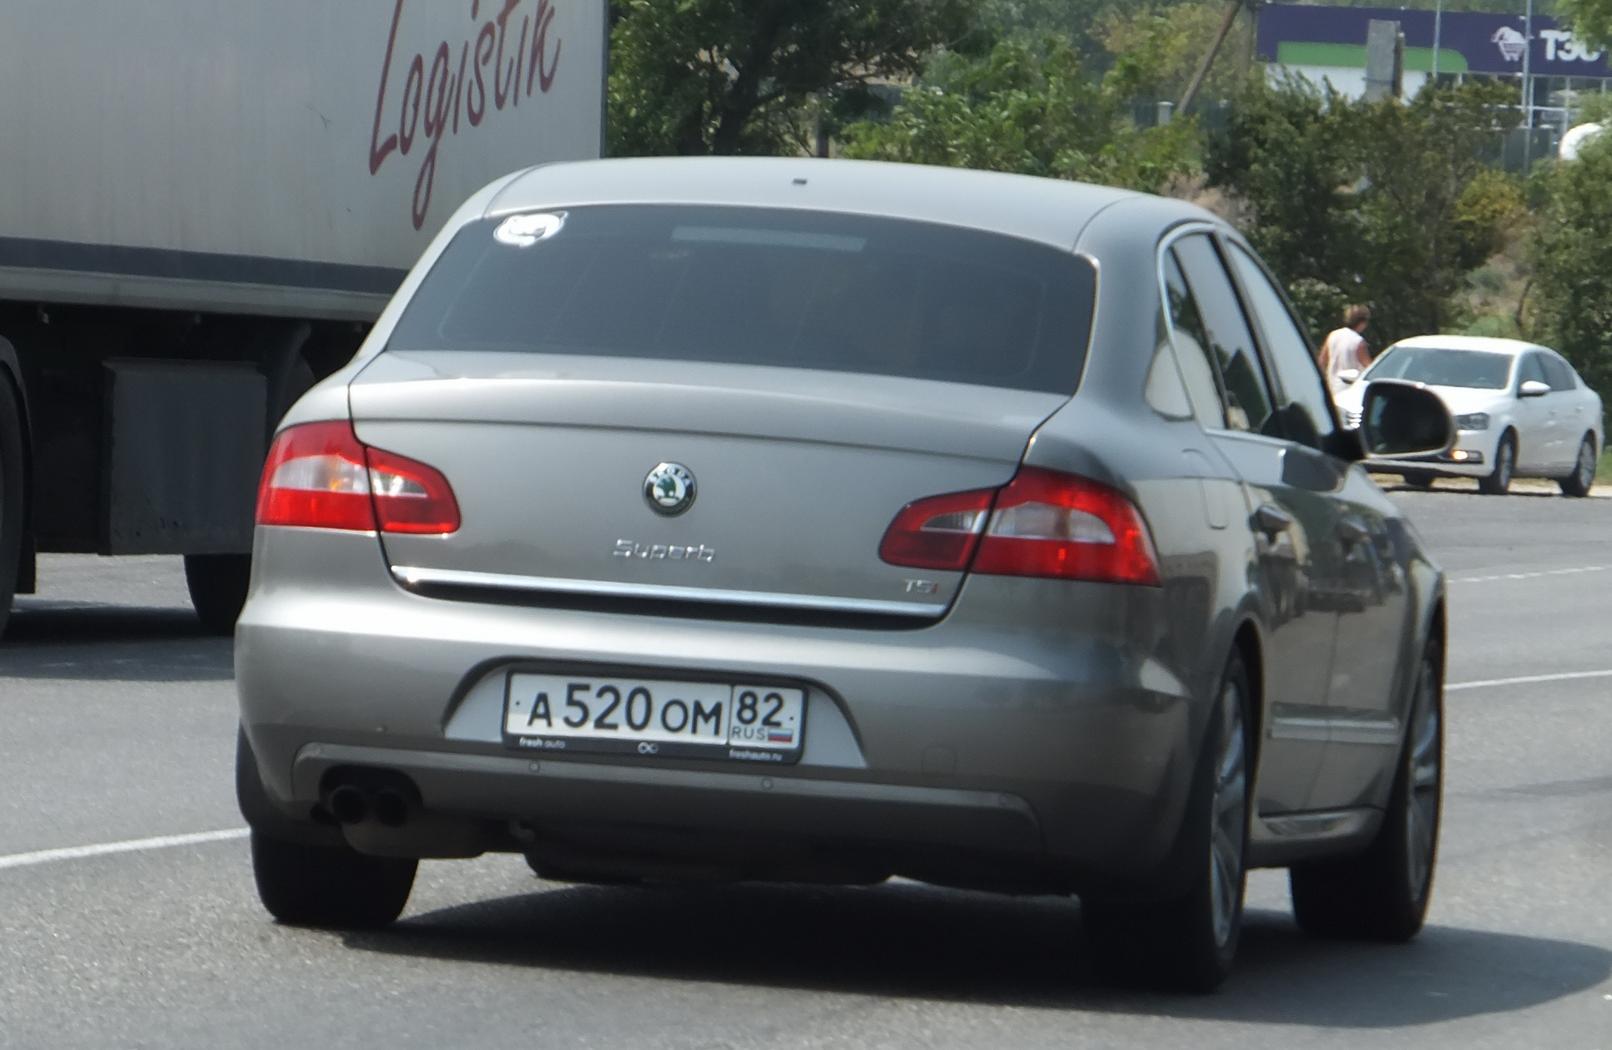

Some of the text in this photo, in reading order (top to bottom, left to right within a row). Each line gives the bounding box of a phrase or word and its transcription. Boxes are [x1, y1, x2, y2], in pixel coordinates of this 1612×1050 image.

[369, 0, 562, 231] Logistik
[612, 538, 715, 562] Superb
[736, 691, 784, 727] 82
[731, 725, 766, 740] RUS
